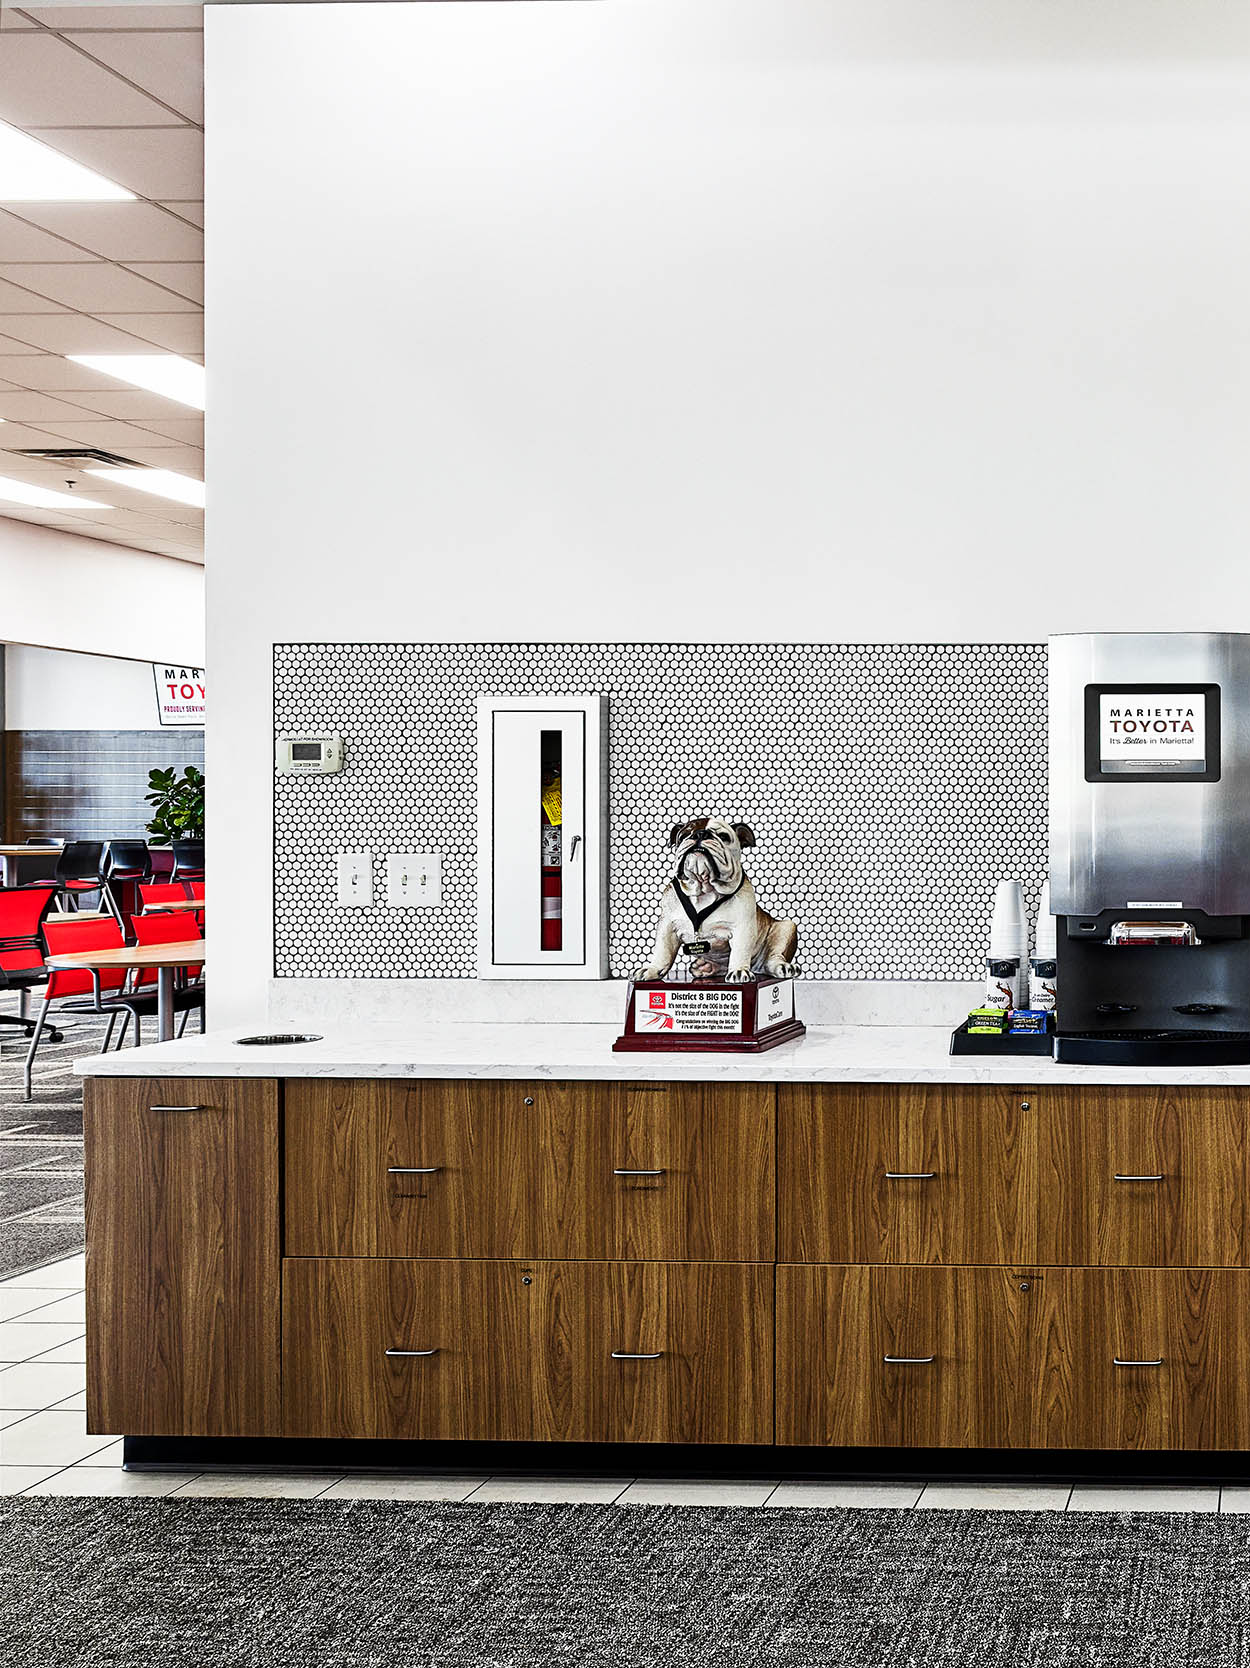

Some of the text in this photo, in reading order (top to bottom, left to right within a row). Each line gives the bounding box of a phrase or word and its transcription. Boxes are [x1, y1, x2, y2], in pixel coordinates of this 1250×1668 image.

[1110, 708, 1194, 717] MARIETTA
[1110, 720, 1194, 733] TOYOTA
[1110, 737, 1121, 745] It's
[1159, 737, 1194, 745] Marietta!
[671, 992, 737, 1001] District 8 BIG DOG
[987, 993, 1006, 1003] Sugar
